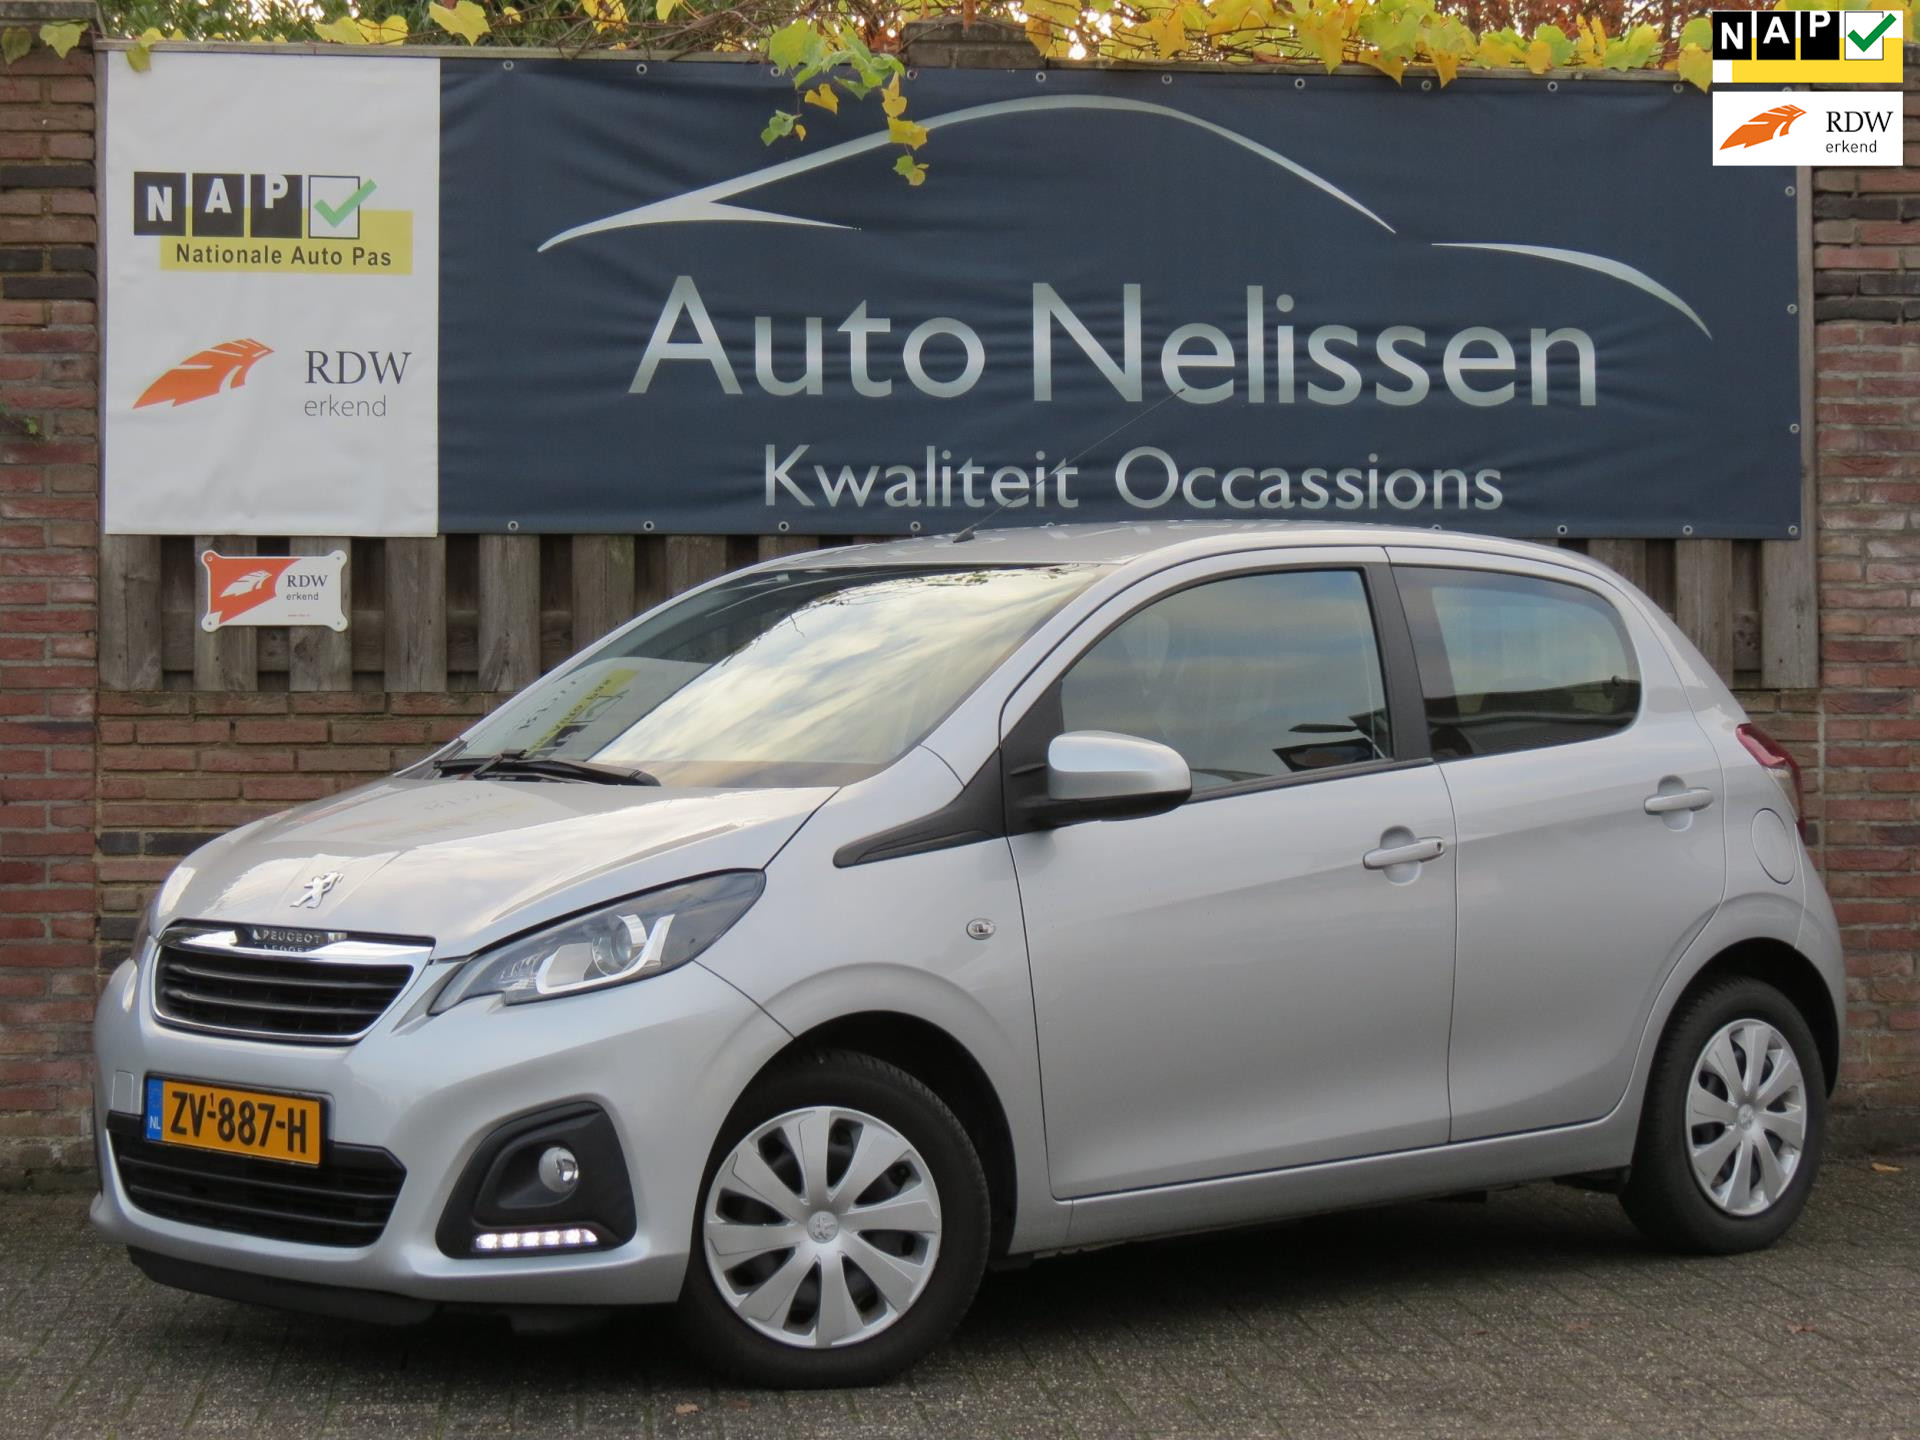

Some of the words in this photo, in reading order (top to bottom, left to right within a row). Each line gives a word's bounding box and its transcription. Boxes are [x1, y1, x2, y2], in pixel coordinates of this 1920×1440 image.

[146, 175, 289, 222] NAP
[176, 243, 282, 264] Nationale
[290, 246, 343, 266] Auto
[352, 247, 391, 266] Pas
[628, 275, 985, 398] Auto
[1032, 282, 1597, 407] Nelissen
[305, 350, 412, 385] RDW
[304, 395, 386, 417] erkend
[765, 444, 1079, 508] Kwaliteit
[1115, 446, 1503, 510] Occassions
[286, 574, 328, 588] RDW
[286, 592, 319, 601] erkend
[262, 930, 321, 944] PEUGEOT
[150, 1115, 161, 1130] NL
[170, 1090, 307, 1154] ZV-887-H
